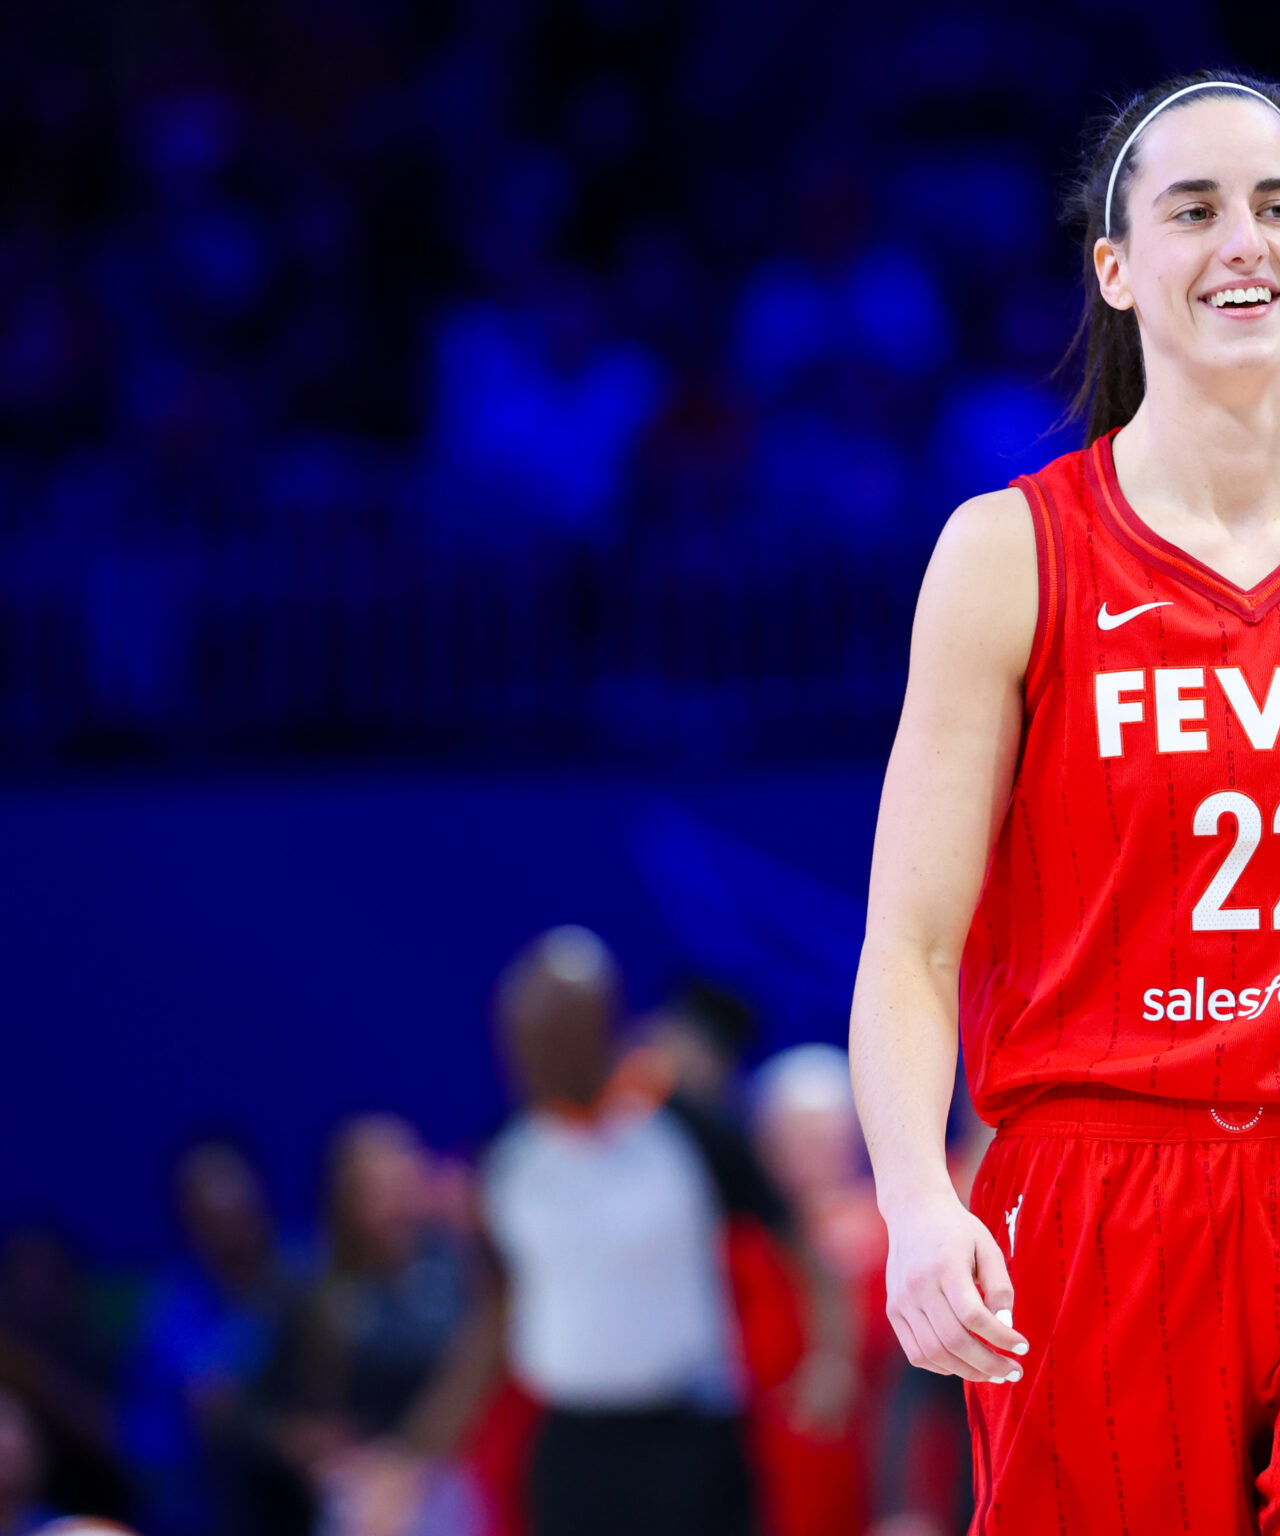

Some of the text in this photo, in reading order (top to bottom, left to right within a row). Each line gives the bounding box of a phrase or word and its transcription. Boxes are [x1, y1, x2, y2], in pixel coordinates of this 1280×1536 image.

[1227, 750, 1236, 787] CHO
[1268, 1176, 1279, 1239] CHOSE
[1101, 1345, 1112, 1407] CHOSE
[1111, 1451, 1129, 1536] BASKETB
